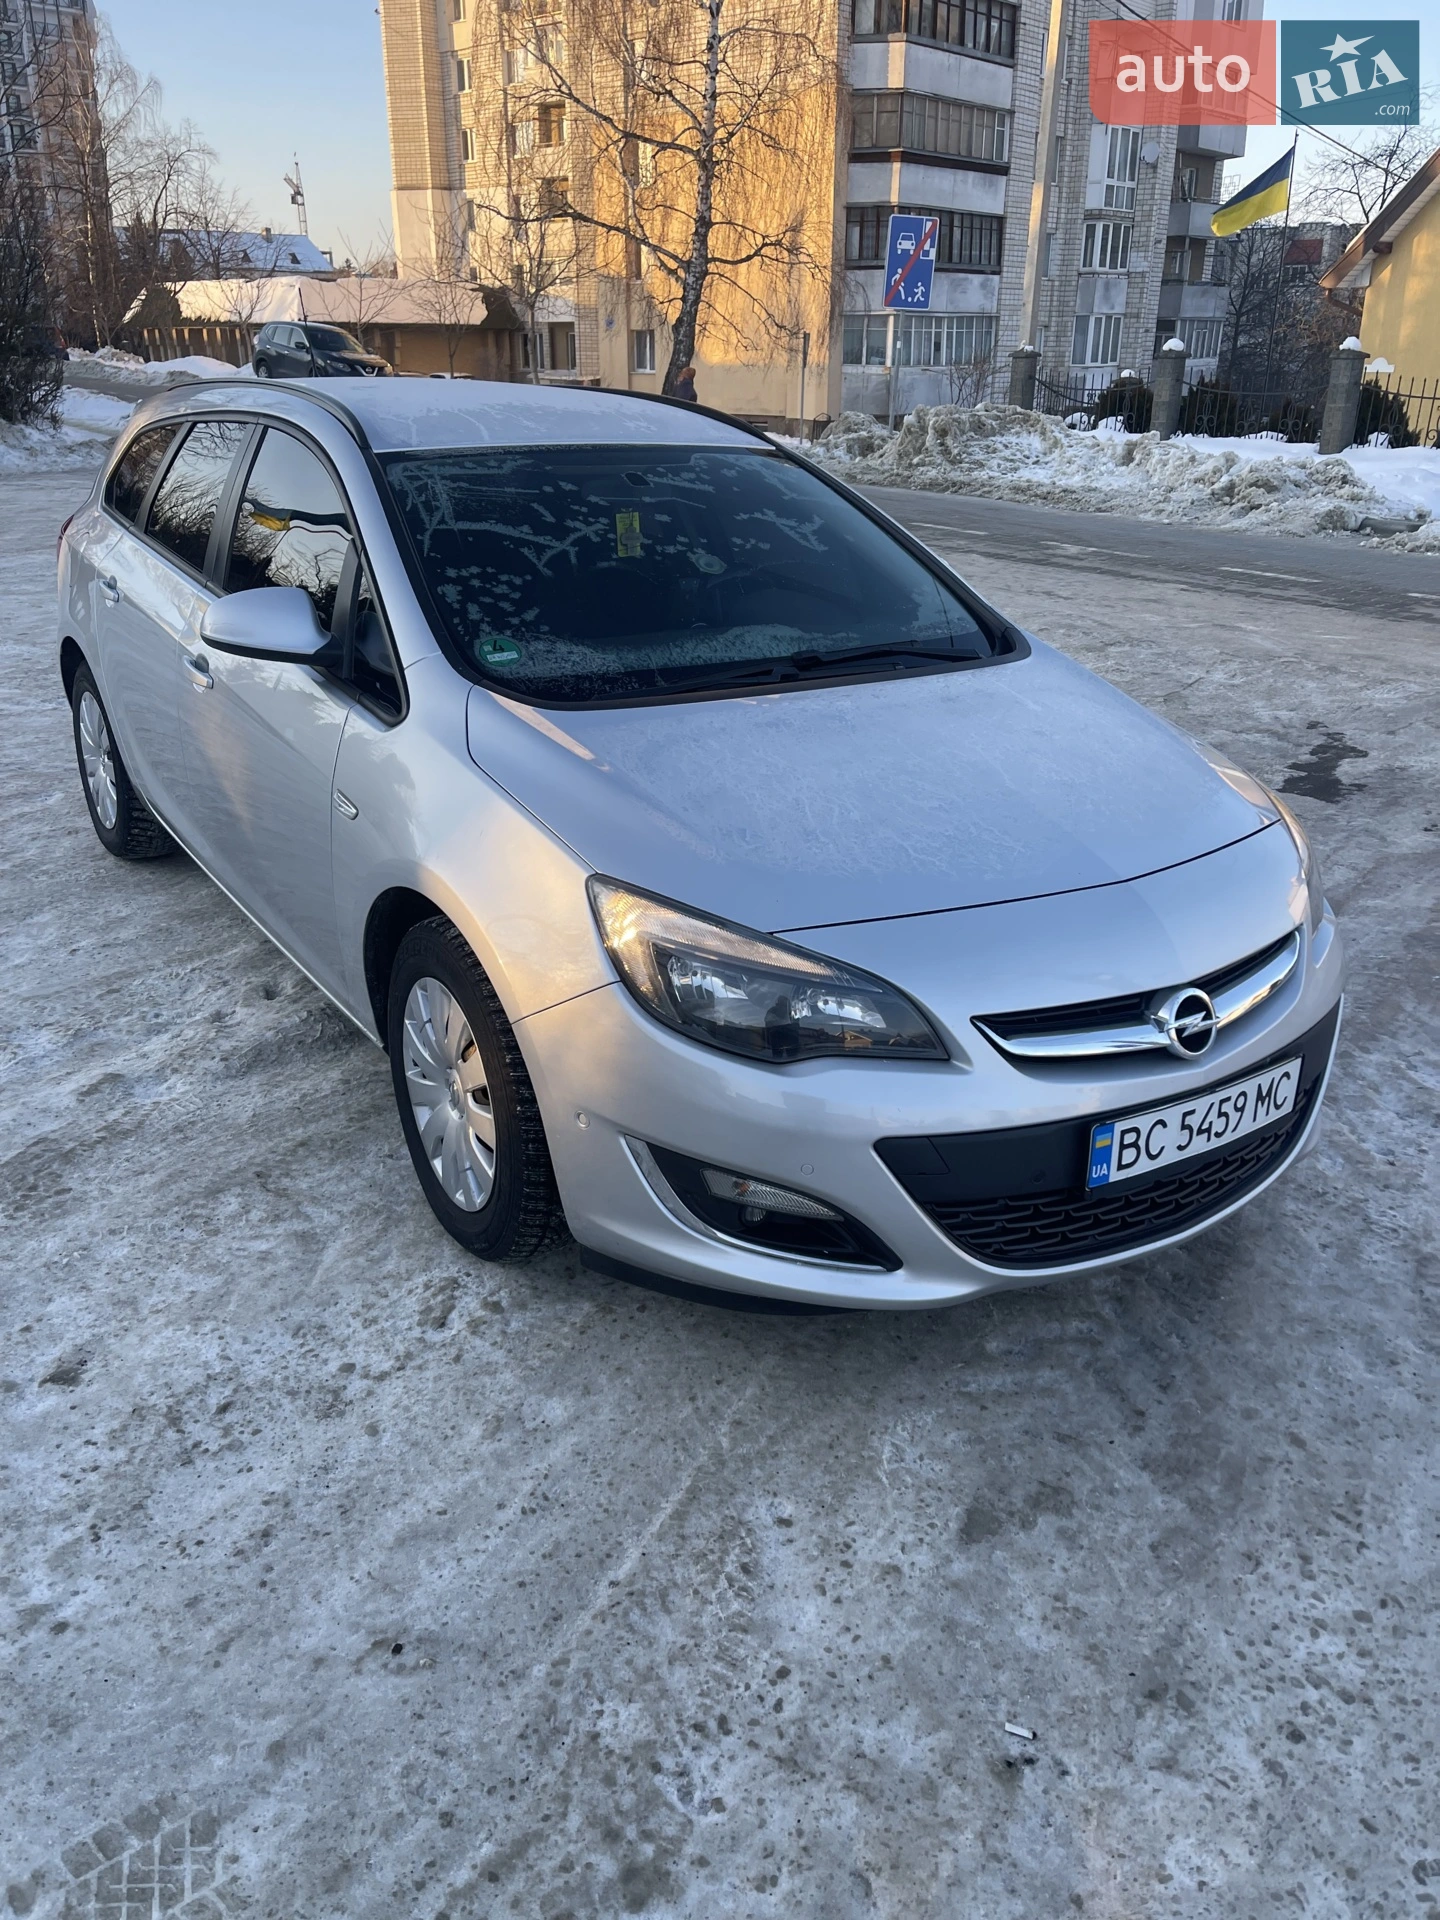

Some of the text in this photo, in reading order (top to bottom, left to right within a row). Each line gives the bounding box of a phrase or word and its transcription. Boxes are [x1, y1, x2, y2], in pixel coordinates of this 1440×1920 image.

[1116, 1070, 1291, 1172] BC 5459 MC
[1092, 1162, 1108, 1178] UA
